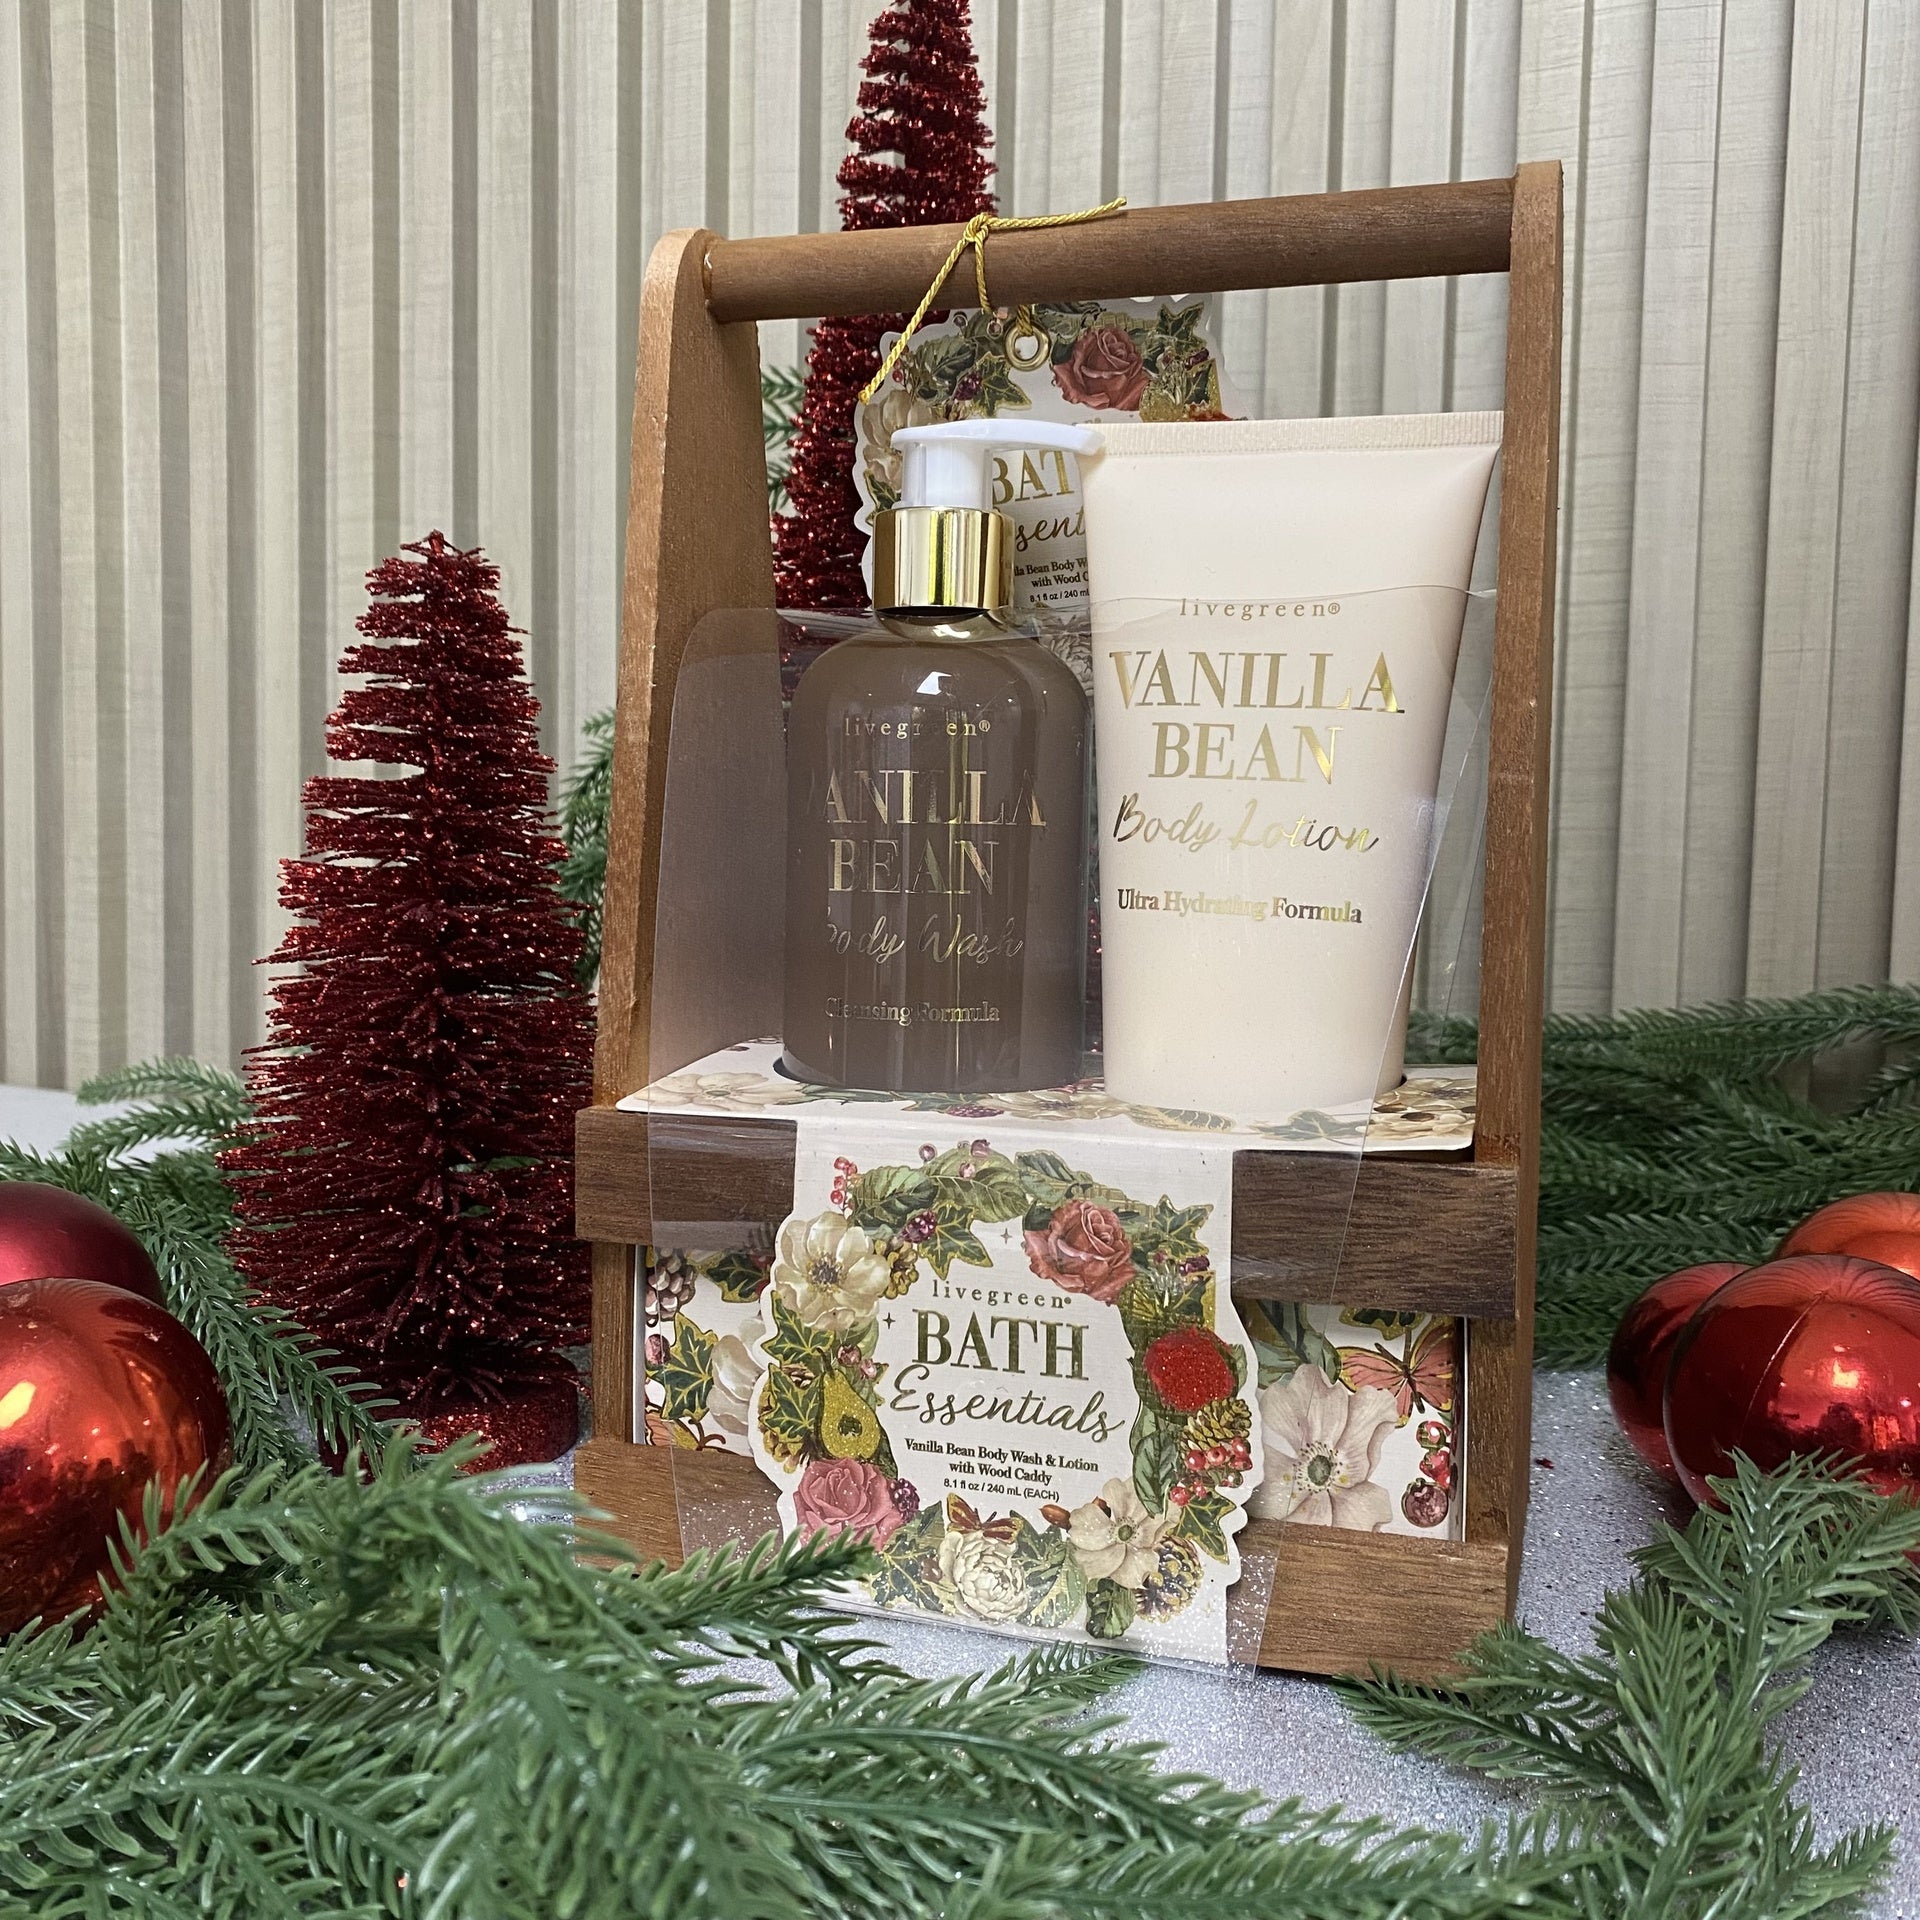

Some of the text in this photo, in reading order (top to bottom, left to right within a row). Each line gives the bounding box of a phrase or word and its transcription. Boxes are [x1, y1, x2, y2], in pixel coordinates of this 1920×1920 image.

[992, 449, 1075, 506] BAT
[1026, 564, 1049, 575] Bean
[1051, 559, 1075, 572] Body
[1031, 575, 1052, 587] with
[1053, 572, 1081, 585] Wood
[1064, 589, 1078, 598] 240
[1109, 649, 1405, 714] VANILLA
[845, 717, 990, 739] livegren®
[1148, 722, 1344, 785] BEAN
[808, 767, 1046, 827] ANILLA
[1113, 792, 1379, 853] Body Lotion
[829, 838, 999, 895] BEAN
[1117, 888, 1363, 924] Ultra Hydrating Formula
[918, 913, 1023, 965] Wash
[825, 997, 1000, 1026] Cleansing Formula
[911, 1308, 1089, 1381] BATH
[890, 1364, 1125, 1443] Essentials
[904, 1438, 1099, 1472] Vanilla Bean Body Wash & Lotion
[949, 1461, 1053, 1486] with Wood Caddy
[943, 1478, 1060, 1502] 8.1 fl oz / 240 mL (EACH)
